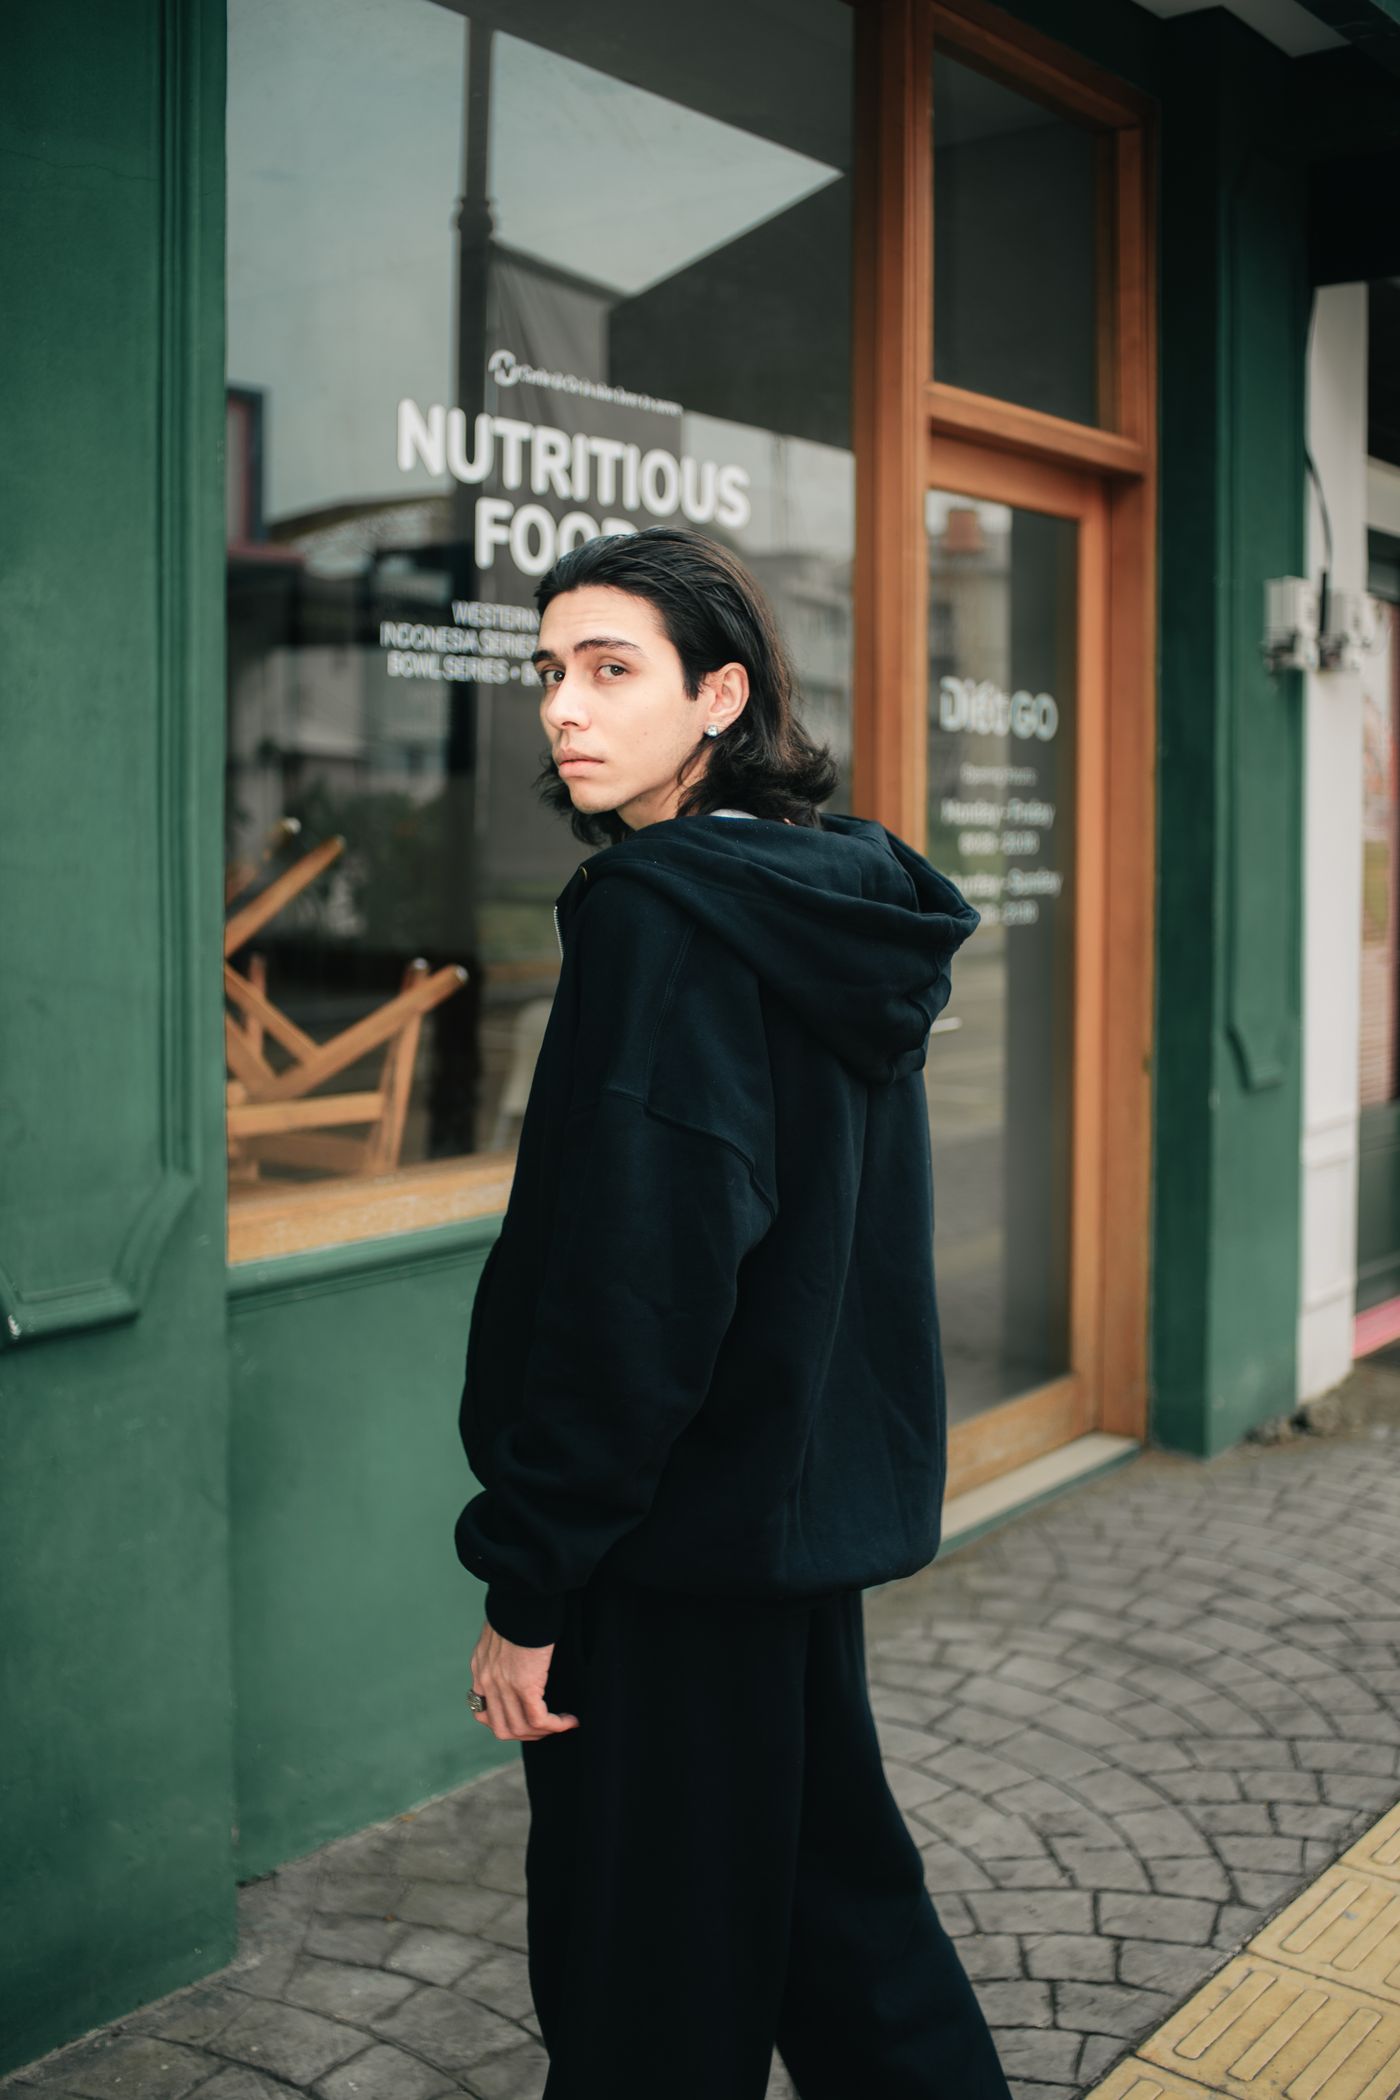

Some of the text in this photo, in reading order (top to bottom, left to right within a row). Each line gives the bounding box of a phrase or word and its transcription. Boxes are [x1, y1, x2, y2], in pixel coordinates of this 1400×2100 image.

[397, 398, 751, 529] NUTRITIOUS
[475, 497, 638, 577] FOO
[387, 650, 443, 680] BOWL
[443, 654, 510, 684] SERIES
